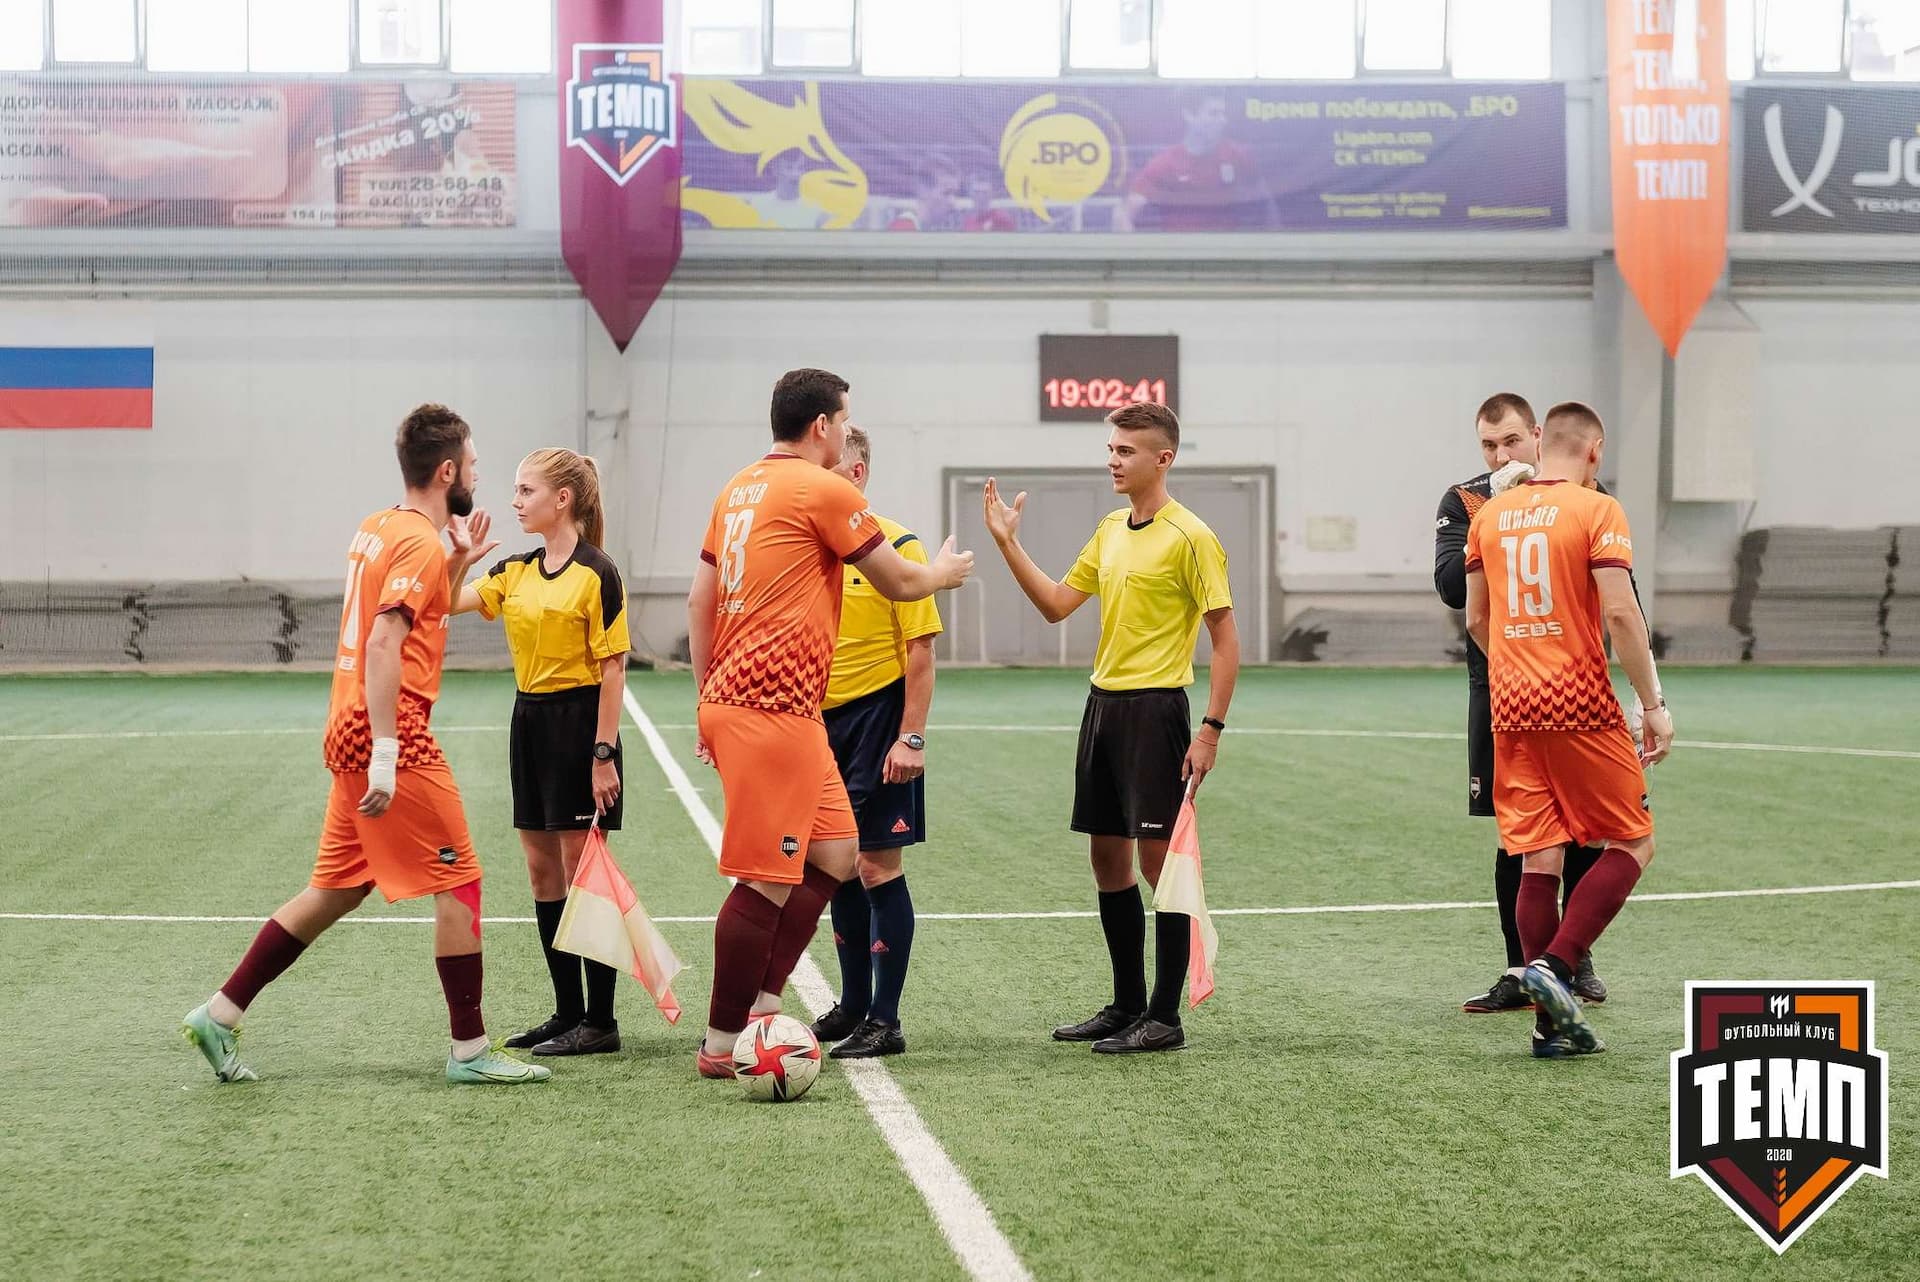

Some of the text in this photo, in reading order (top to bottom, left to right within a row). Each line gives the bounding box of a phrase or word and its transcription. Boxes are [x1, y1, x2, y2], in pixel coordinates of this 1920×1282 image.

[577, 83, 665, 131] ТЕМП
[1619, 104, 1721, 145] ТОЛЬКО
[320, 129, 415, 169] скидка
[421, 105, 482, 139] 20%
[1031, 141, 1100, 165] .БРО
[1633, 160, 1708, 200] ТЕМП!
[1044, 378, 1167, 408] 19:02:41
[728, 483, 769, 508] СЫЧЕВ
[1499, 505, 1560, 531] ШИБАЕВ
[720, 508, 755, 594] 13
[1500, 532, 1554, 618] 19
